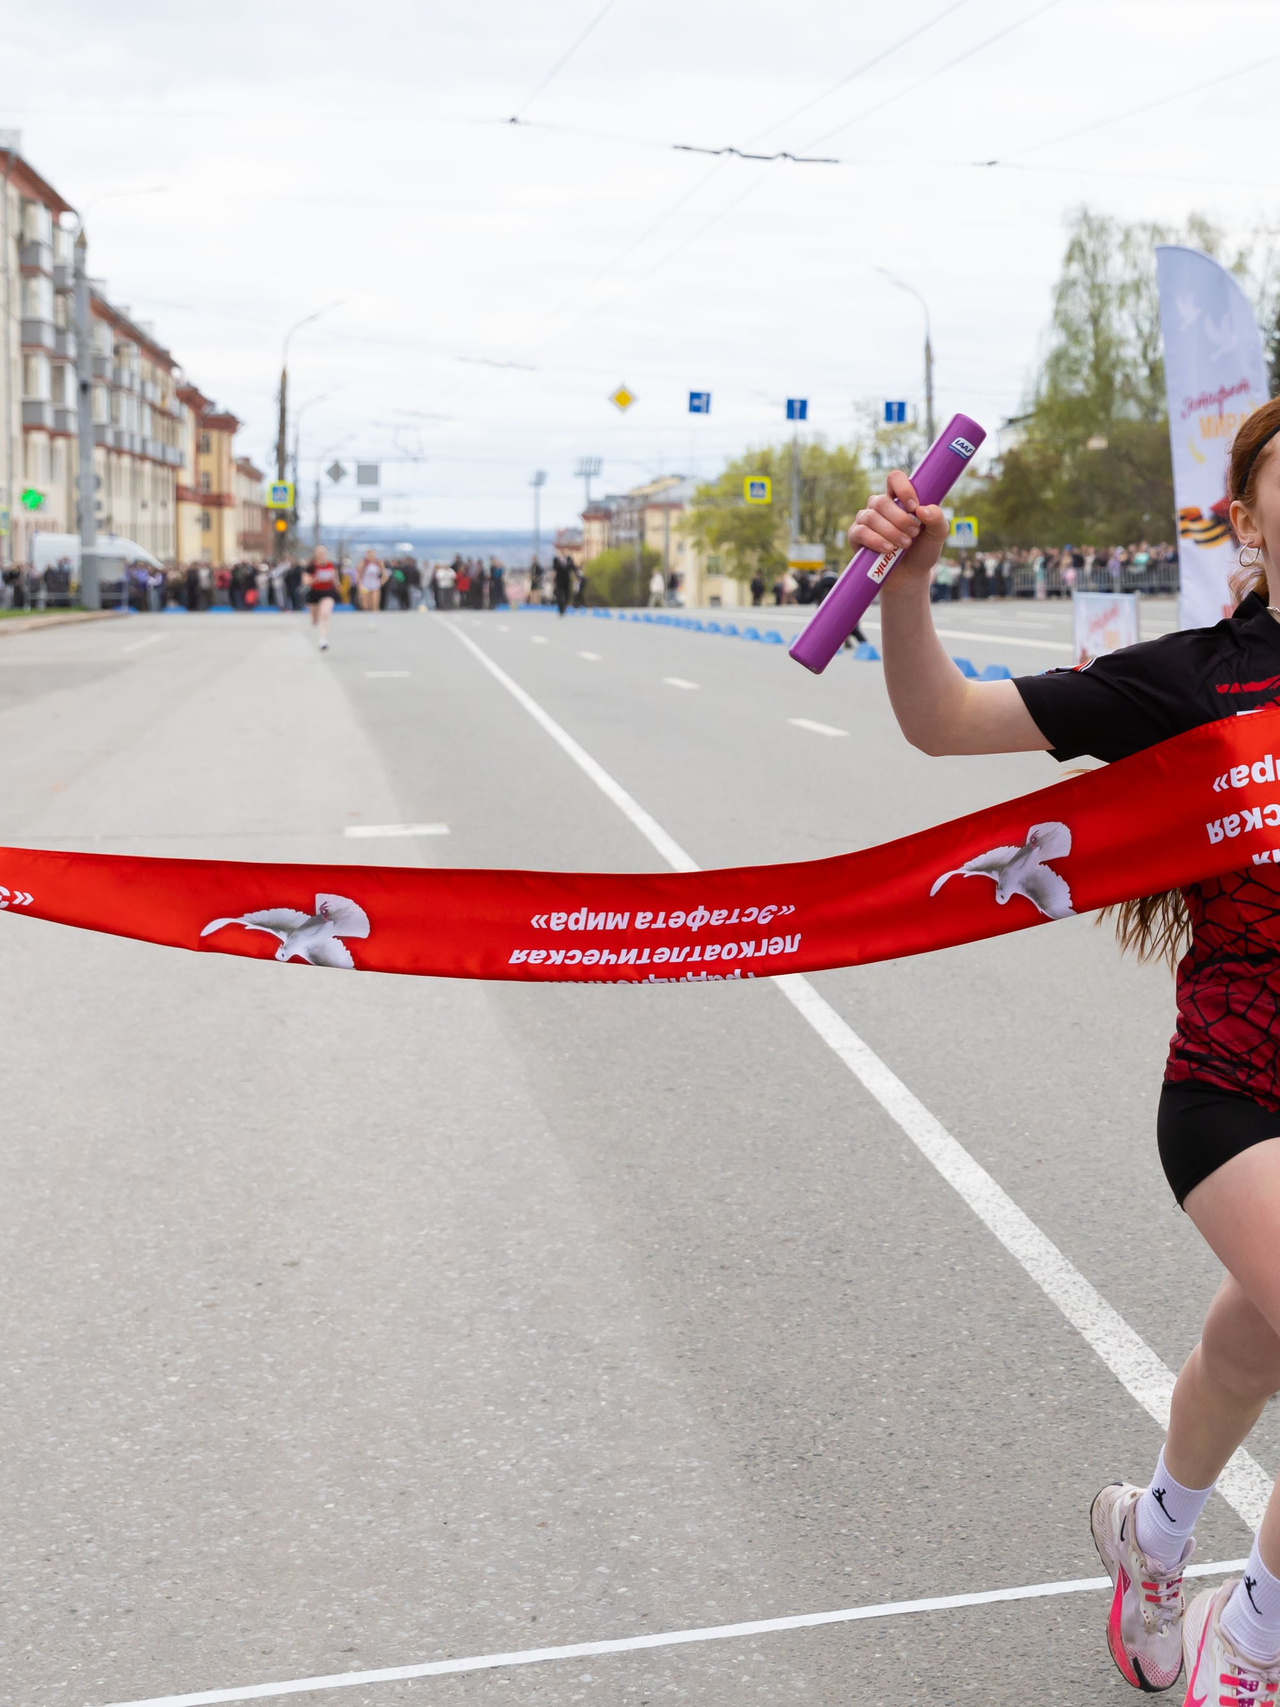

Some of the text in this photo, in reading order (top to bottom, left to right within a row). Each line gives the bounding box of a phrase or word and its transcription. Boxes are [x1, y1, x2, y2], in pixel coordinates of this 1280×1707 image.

[955, 439, 974, 455] IAAF
[530, 905, 796, 932] «Эстафета мира»
[508, 933, 802, 966] легкоатлетическая
